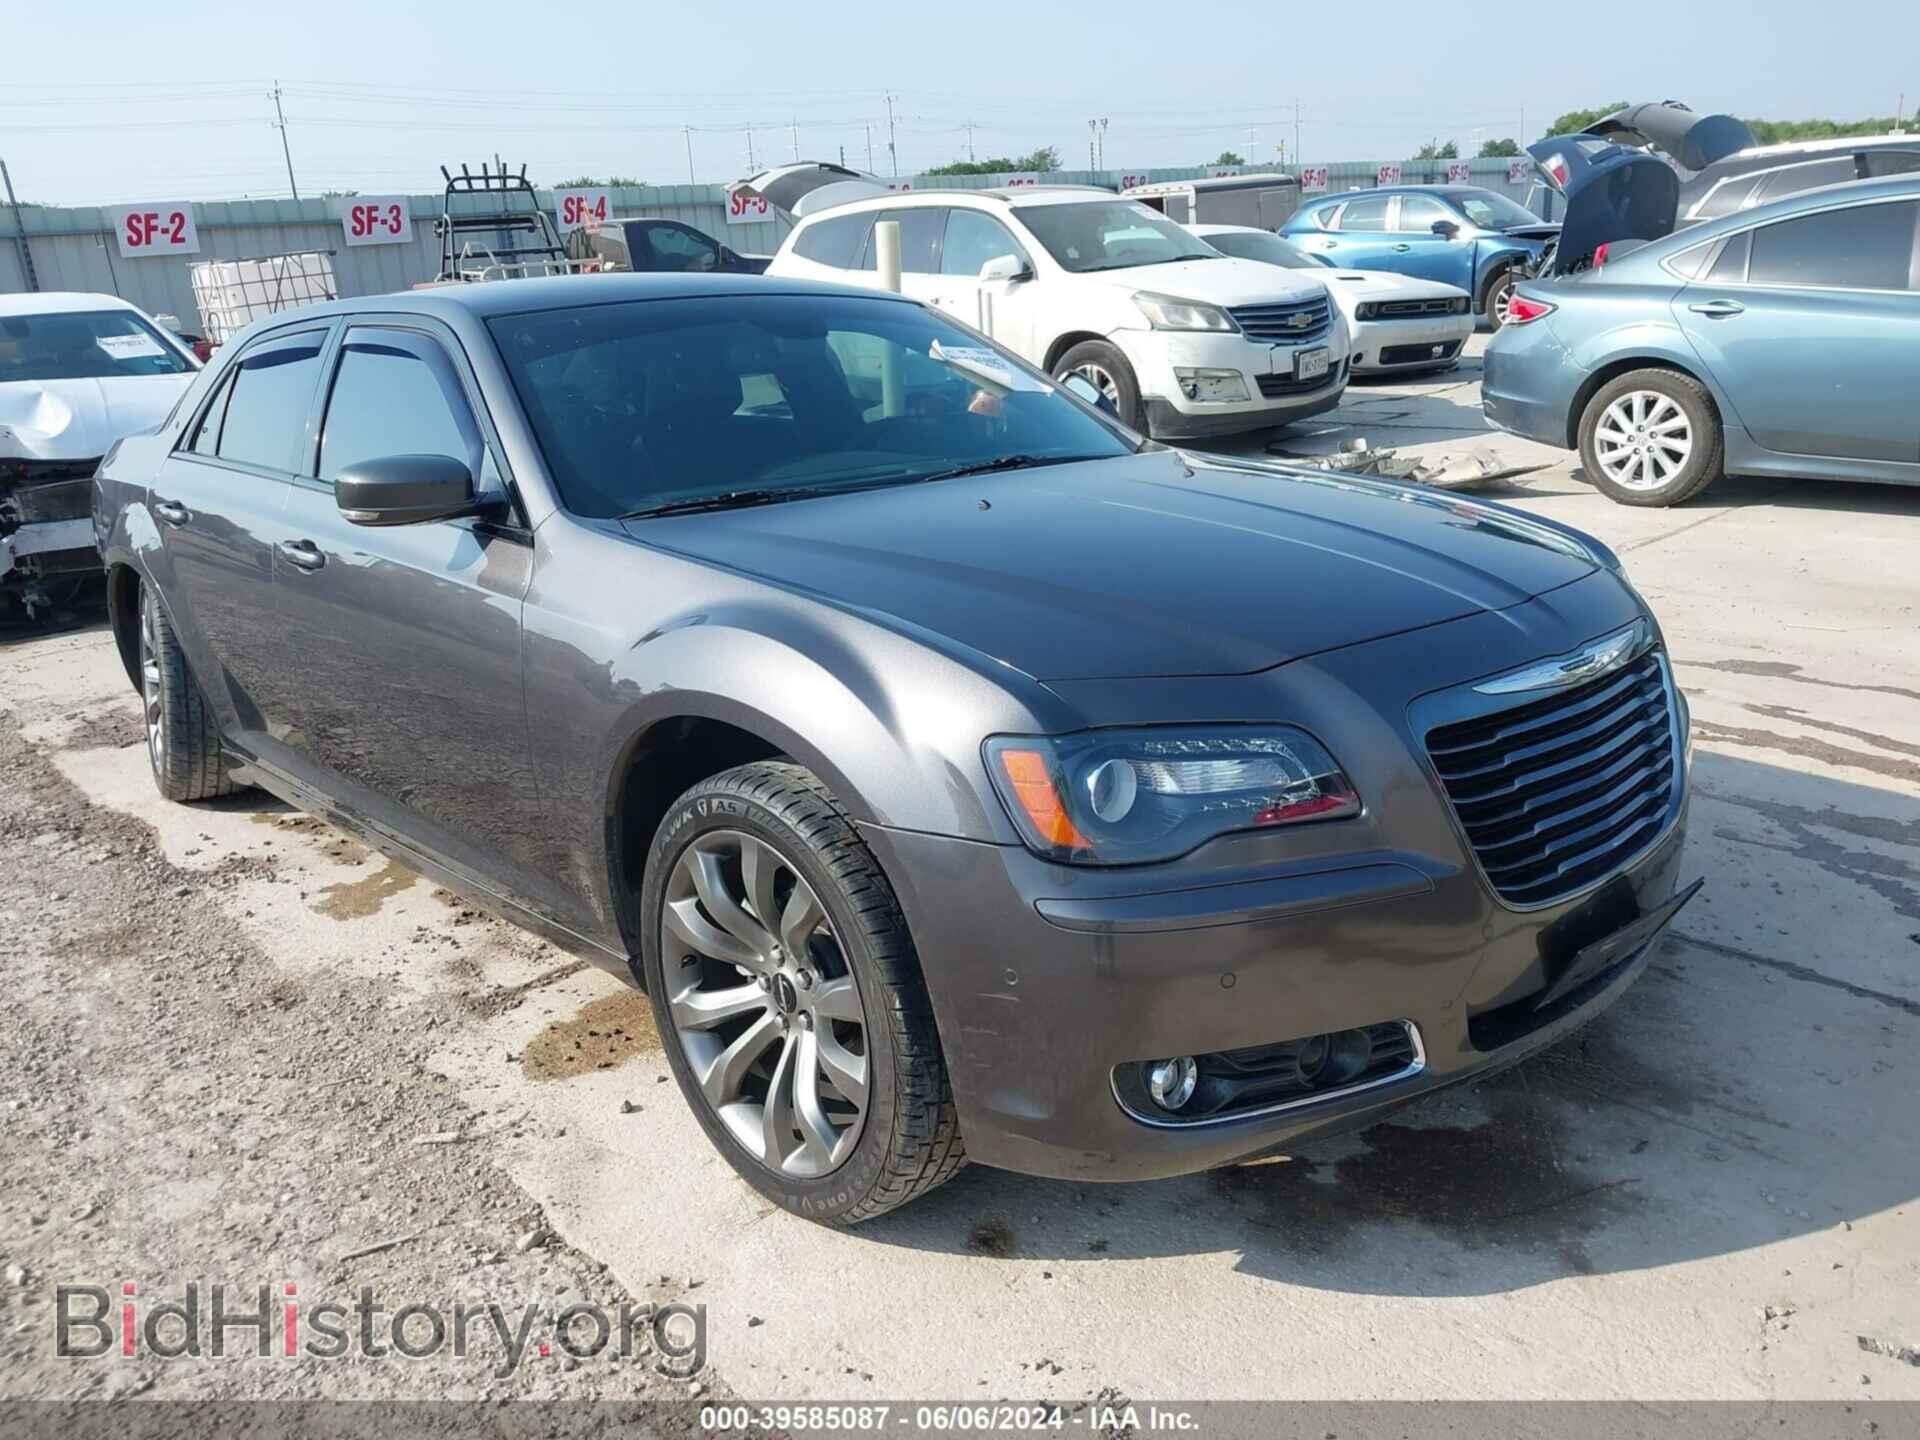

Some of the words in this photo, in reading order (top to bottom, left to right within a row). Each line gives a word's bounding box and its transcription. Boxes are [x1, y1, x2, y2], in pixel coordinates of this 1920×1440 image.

[1302, 168, 1327, 188] SF-10
[1379, 165, 1399, 184] SF-11
[351, 204, 402, 237] SF-3
[563, 196, 607, 225] SF-4
[126, 212, 186, 247] SF-2
